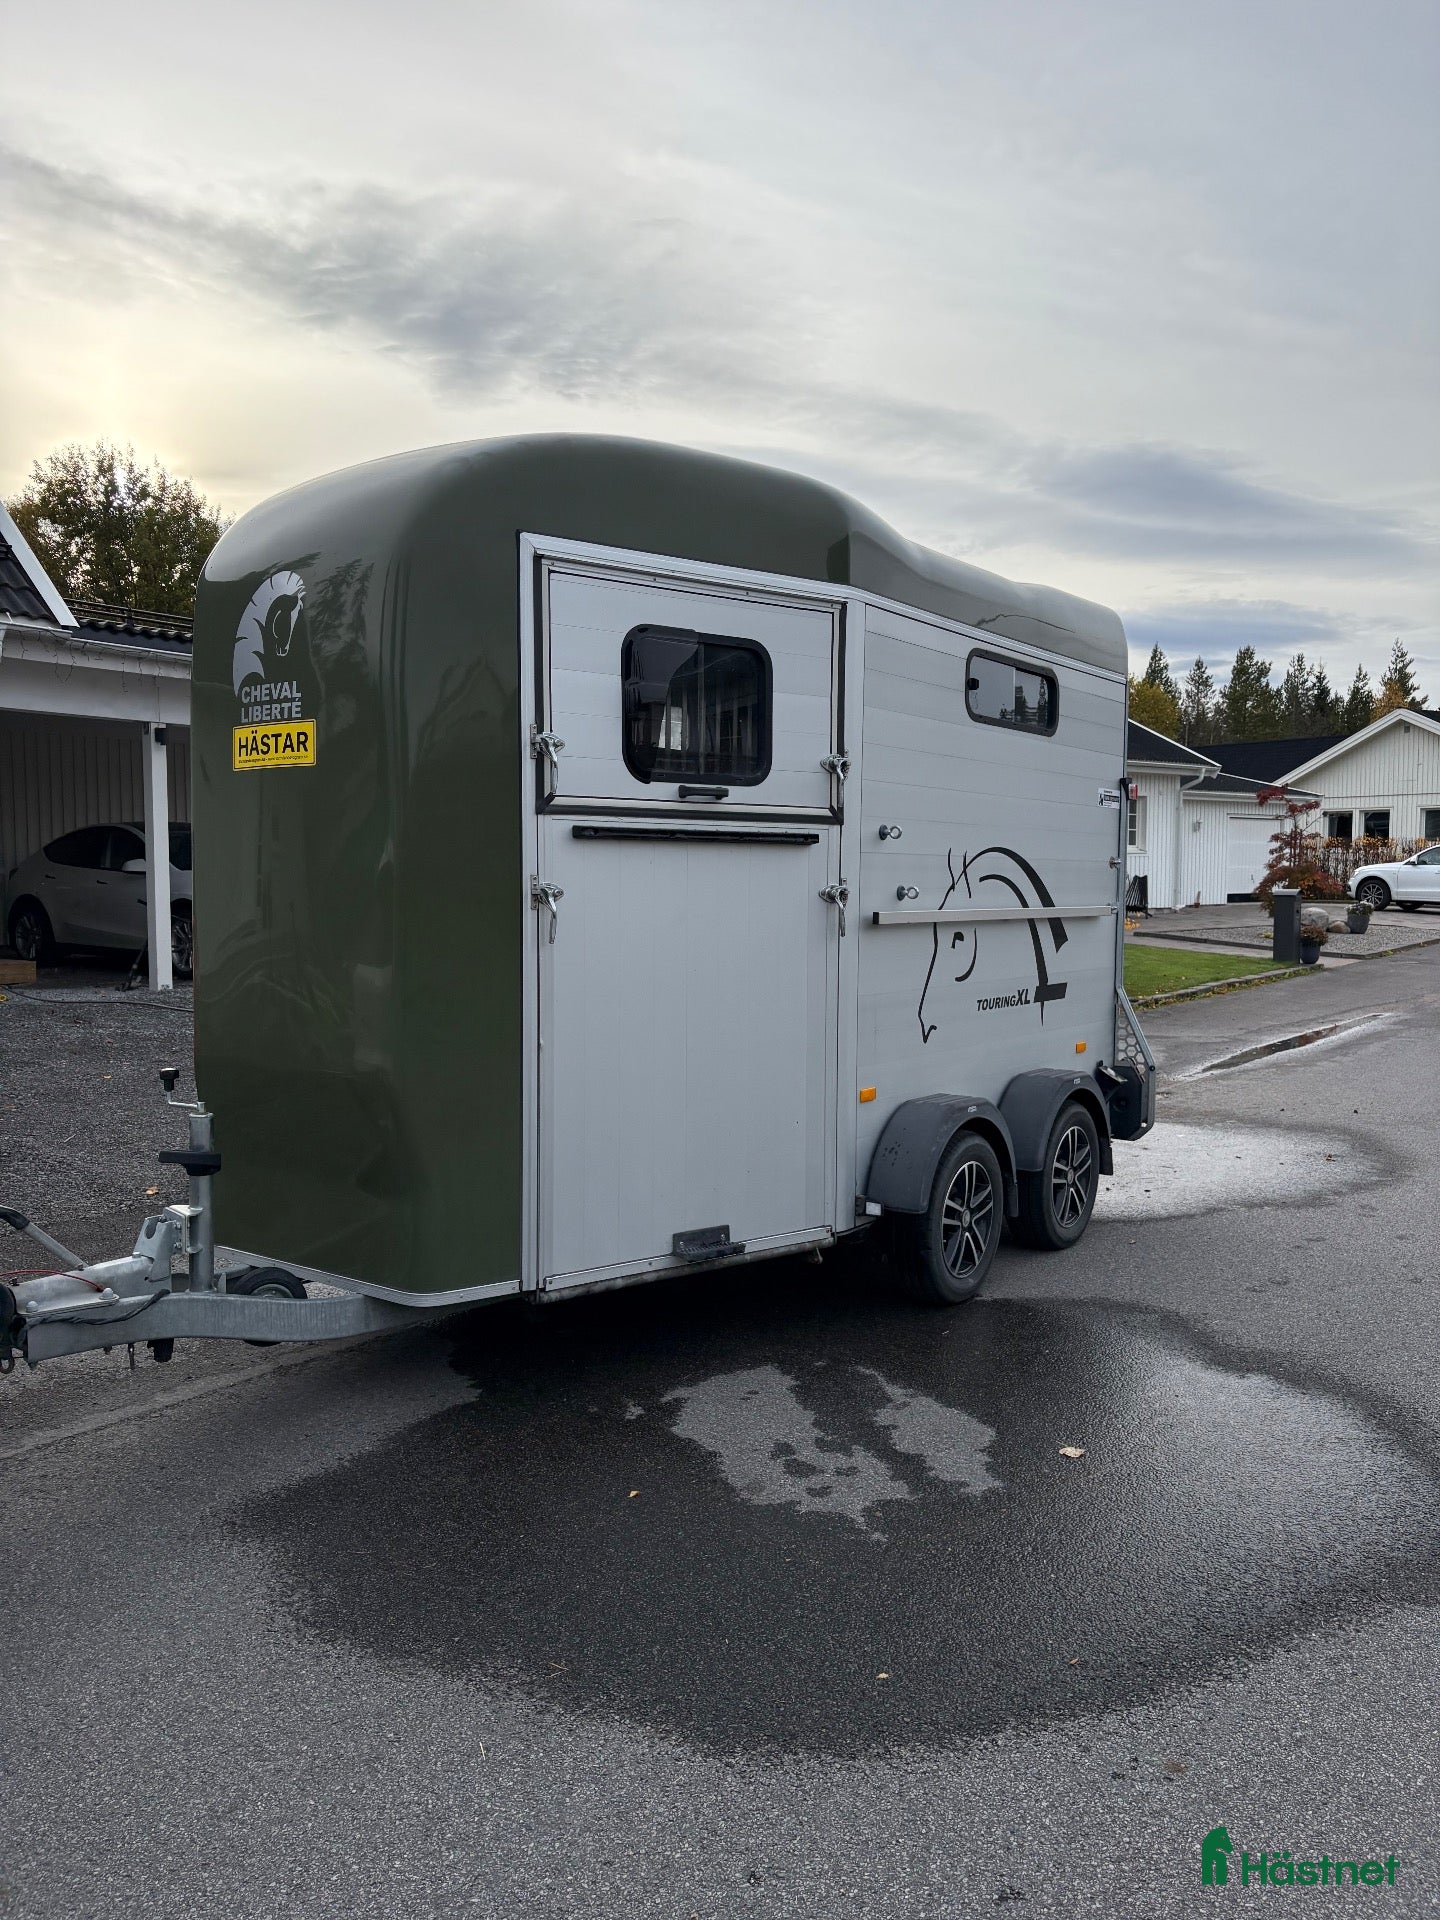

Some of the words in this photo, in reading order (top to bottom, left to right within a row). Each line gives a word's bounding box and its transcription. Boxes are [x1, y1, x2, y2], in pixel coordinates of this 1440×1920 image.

[241, 681, 302, 703] CHEVAL
[241, 698, 302, 723] LIBERTÉ
[238, 729, 309, 757] HÄSTAR
